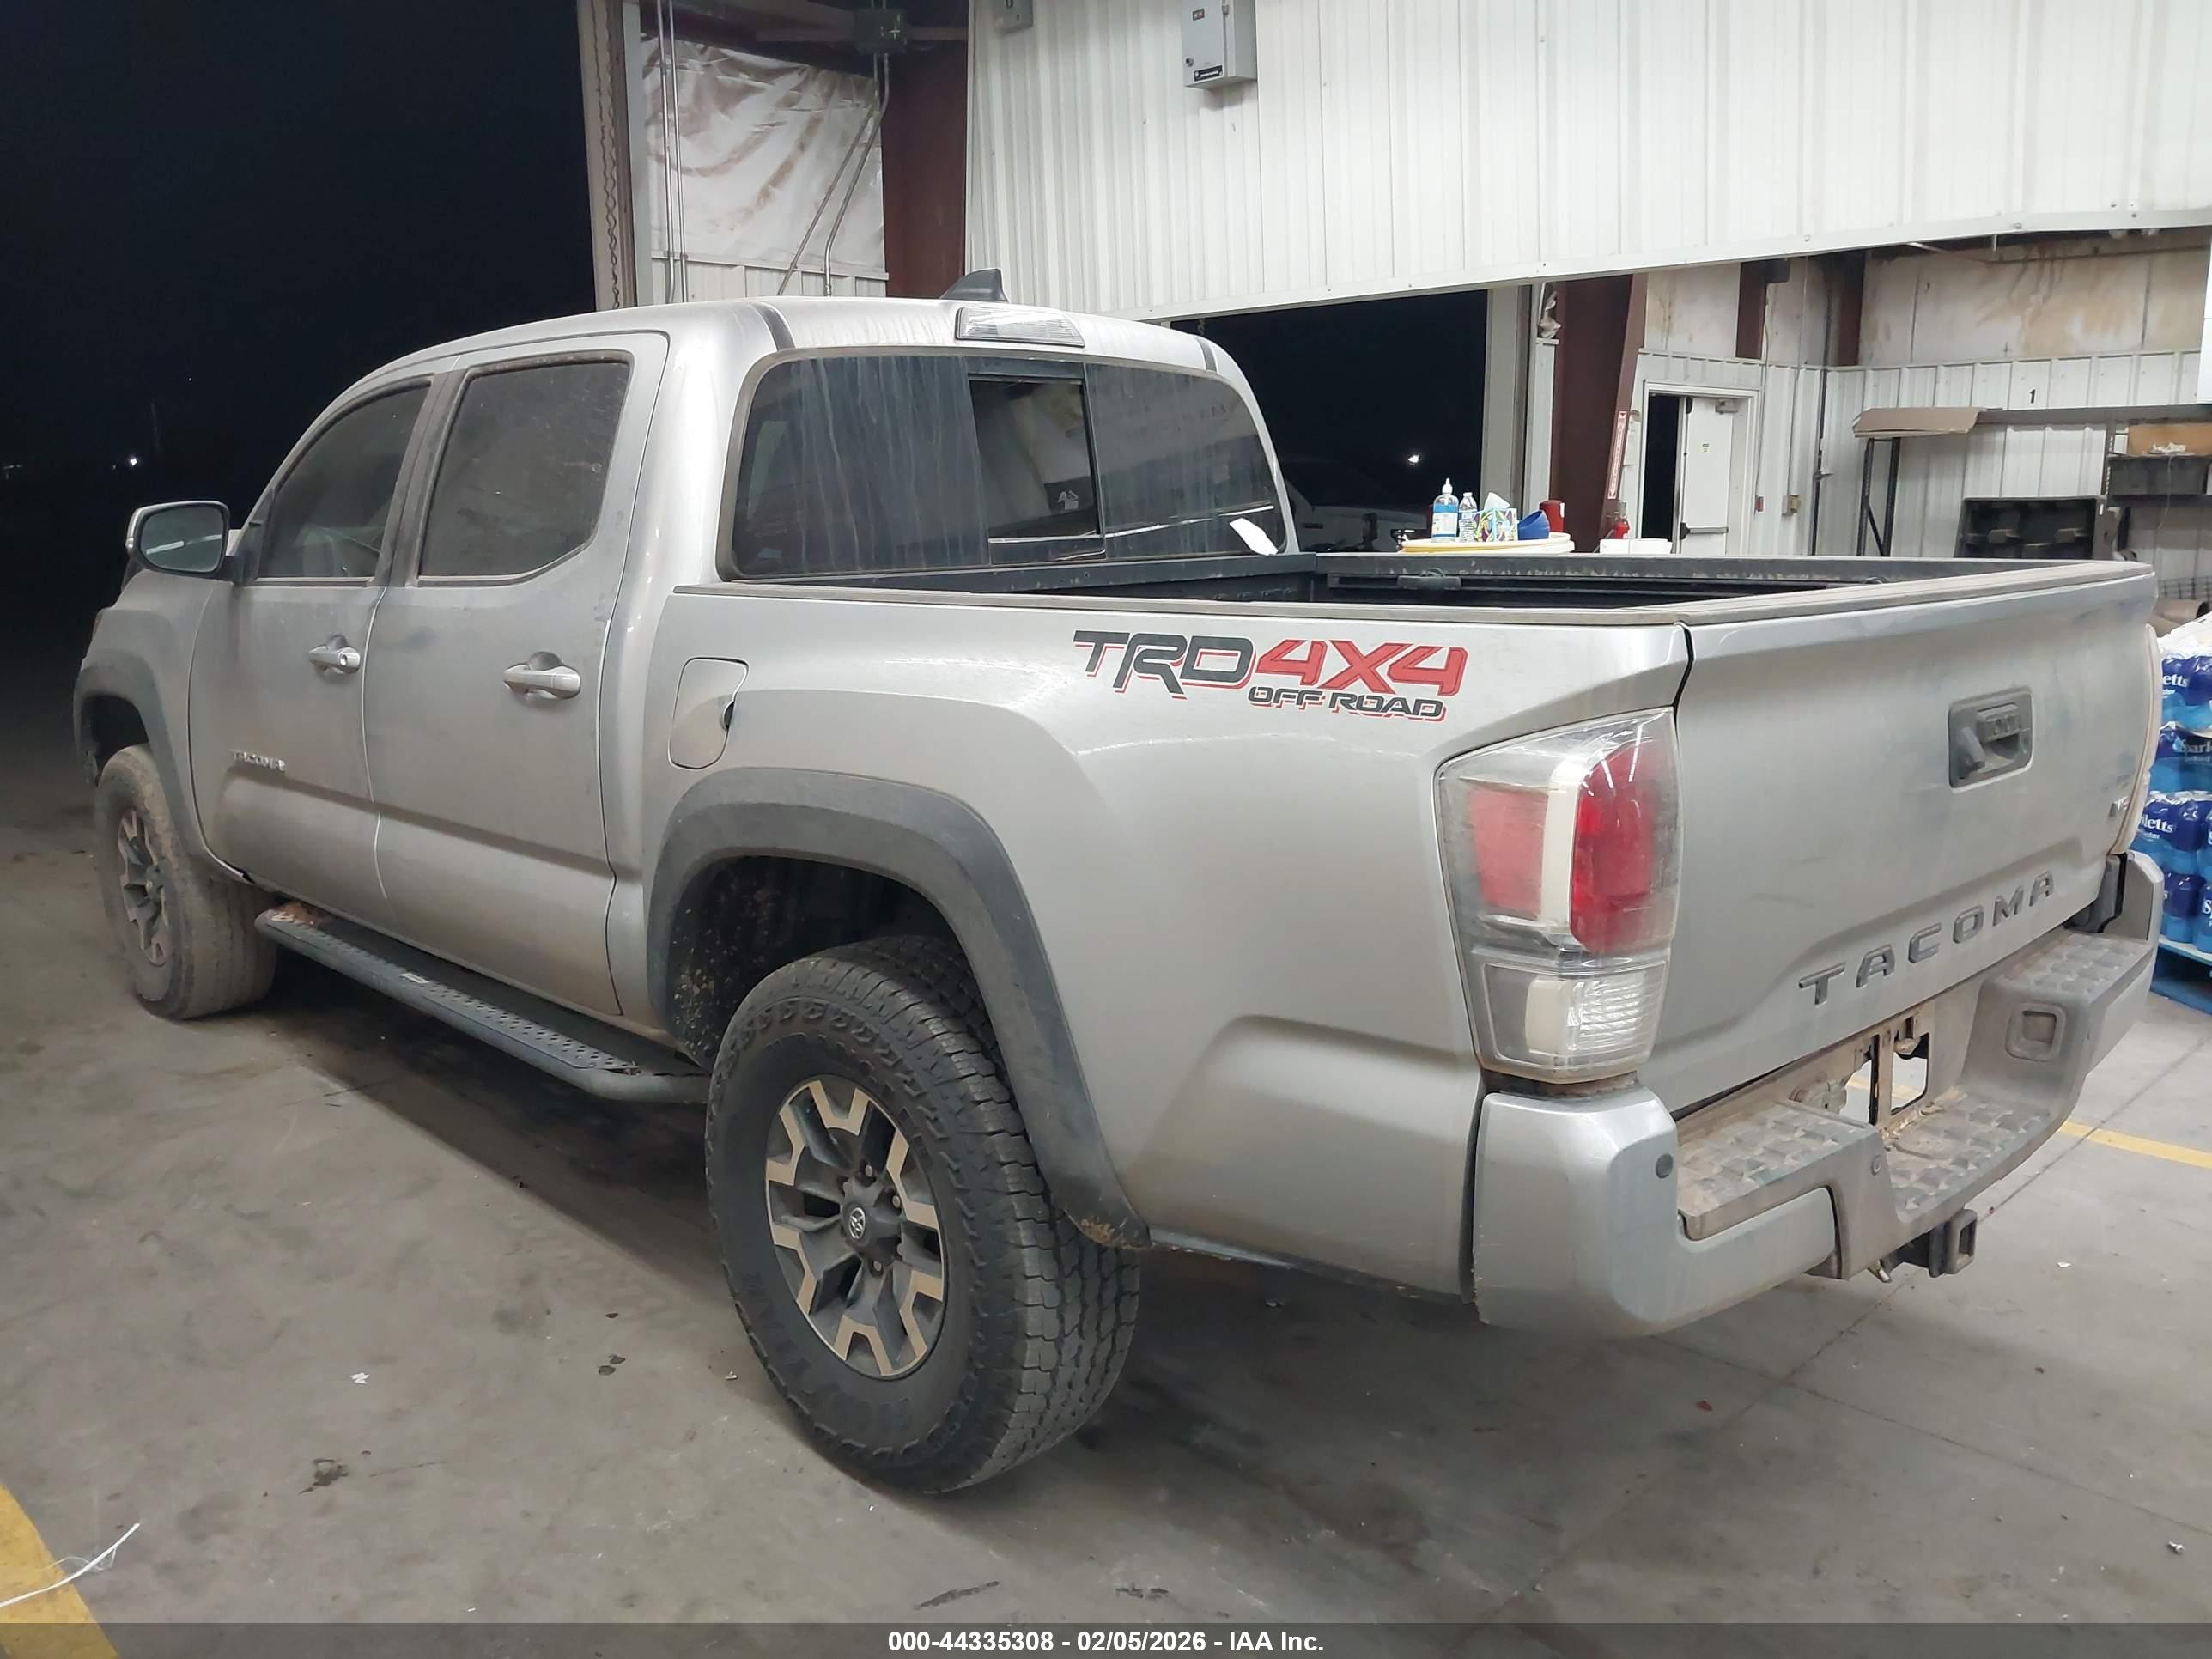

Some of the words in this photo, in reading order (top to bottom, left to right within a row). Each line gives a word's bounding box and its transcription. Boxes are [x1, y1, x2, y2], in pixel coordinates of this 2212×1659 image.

[2029, 388, 2036, 404] 1
[1073, 630, 1256, 700] TRD
[1255, 639, 1468, 697] 4X4
[2163, 673, 2188, 688] etts
[1248, 686, 1323, 710] OFF
[1328, 692, 1447, 721] ROAD
[2142, 814, 2174, 833] letts
[1798, 870, 2055, 1006] TACOMA
